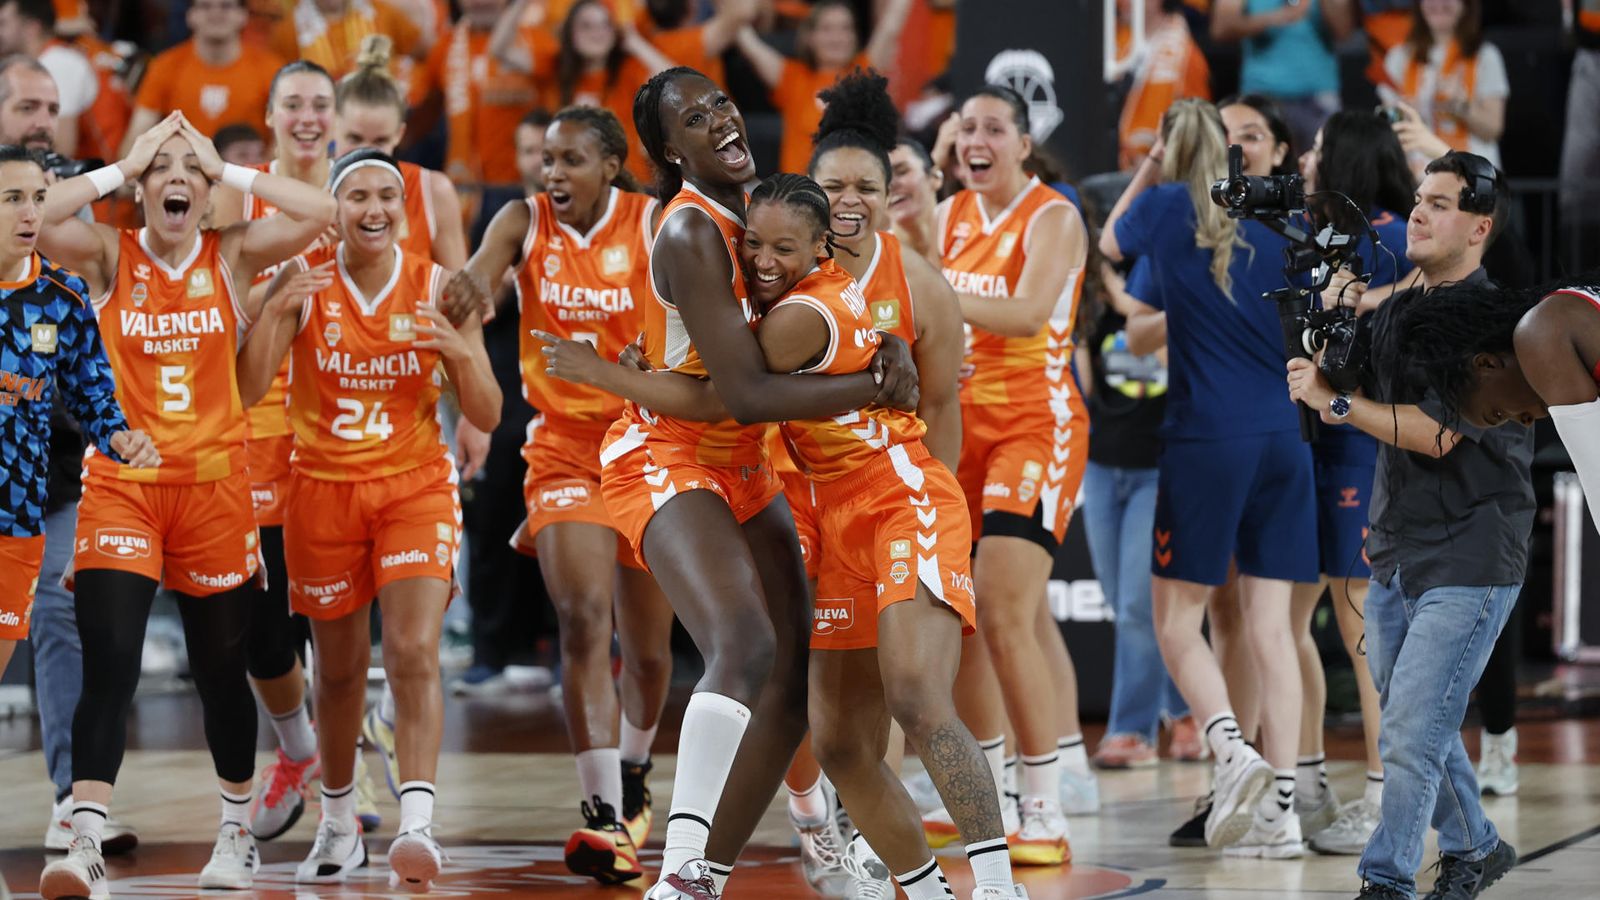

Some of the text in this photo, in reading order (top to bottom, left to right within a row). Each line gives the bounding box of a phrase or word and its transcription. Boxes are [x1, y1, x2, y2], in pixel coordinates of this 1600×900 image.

[541, 277, 634, 312] VALENCIA
[120, 307, 225, 337] VALENCIA
[143, 337, 200, 354] BASKET
[315, 348, 421, 376] VALENCIA
[161, 365, 191, 412] 5
[339, 377, 397, 391] BASKET
[331, 398, 394, 441] 24
[99, 534, 149, 550] PULEVA
[303, 580, 349, 597] PULEVA
[814, 607, 849, 620] ULEVA
